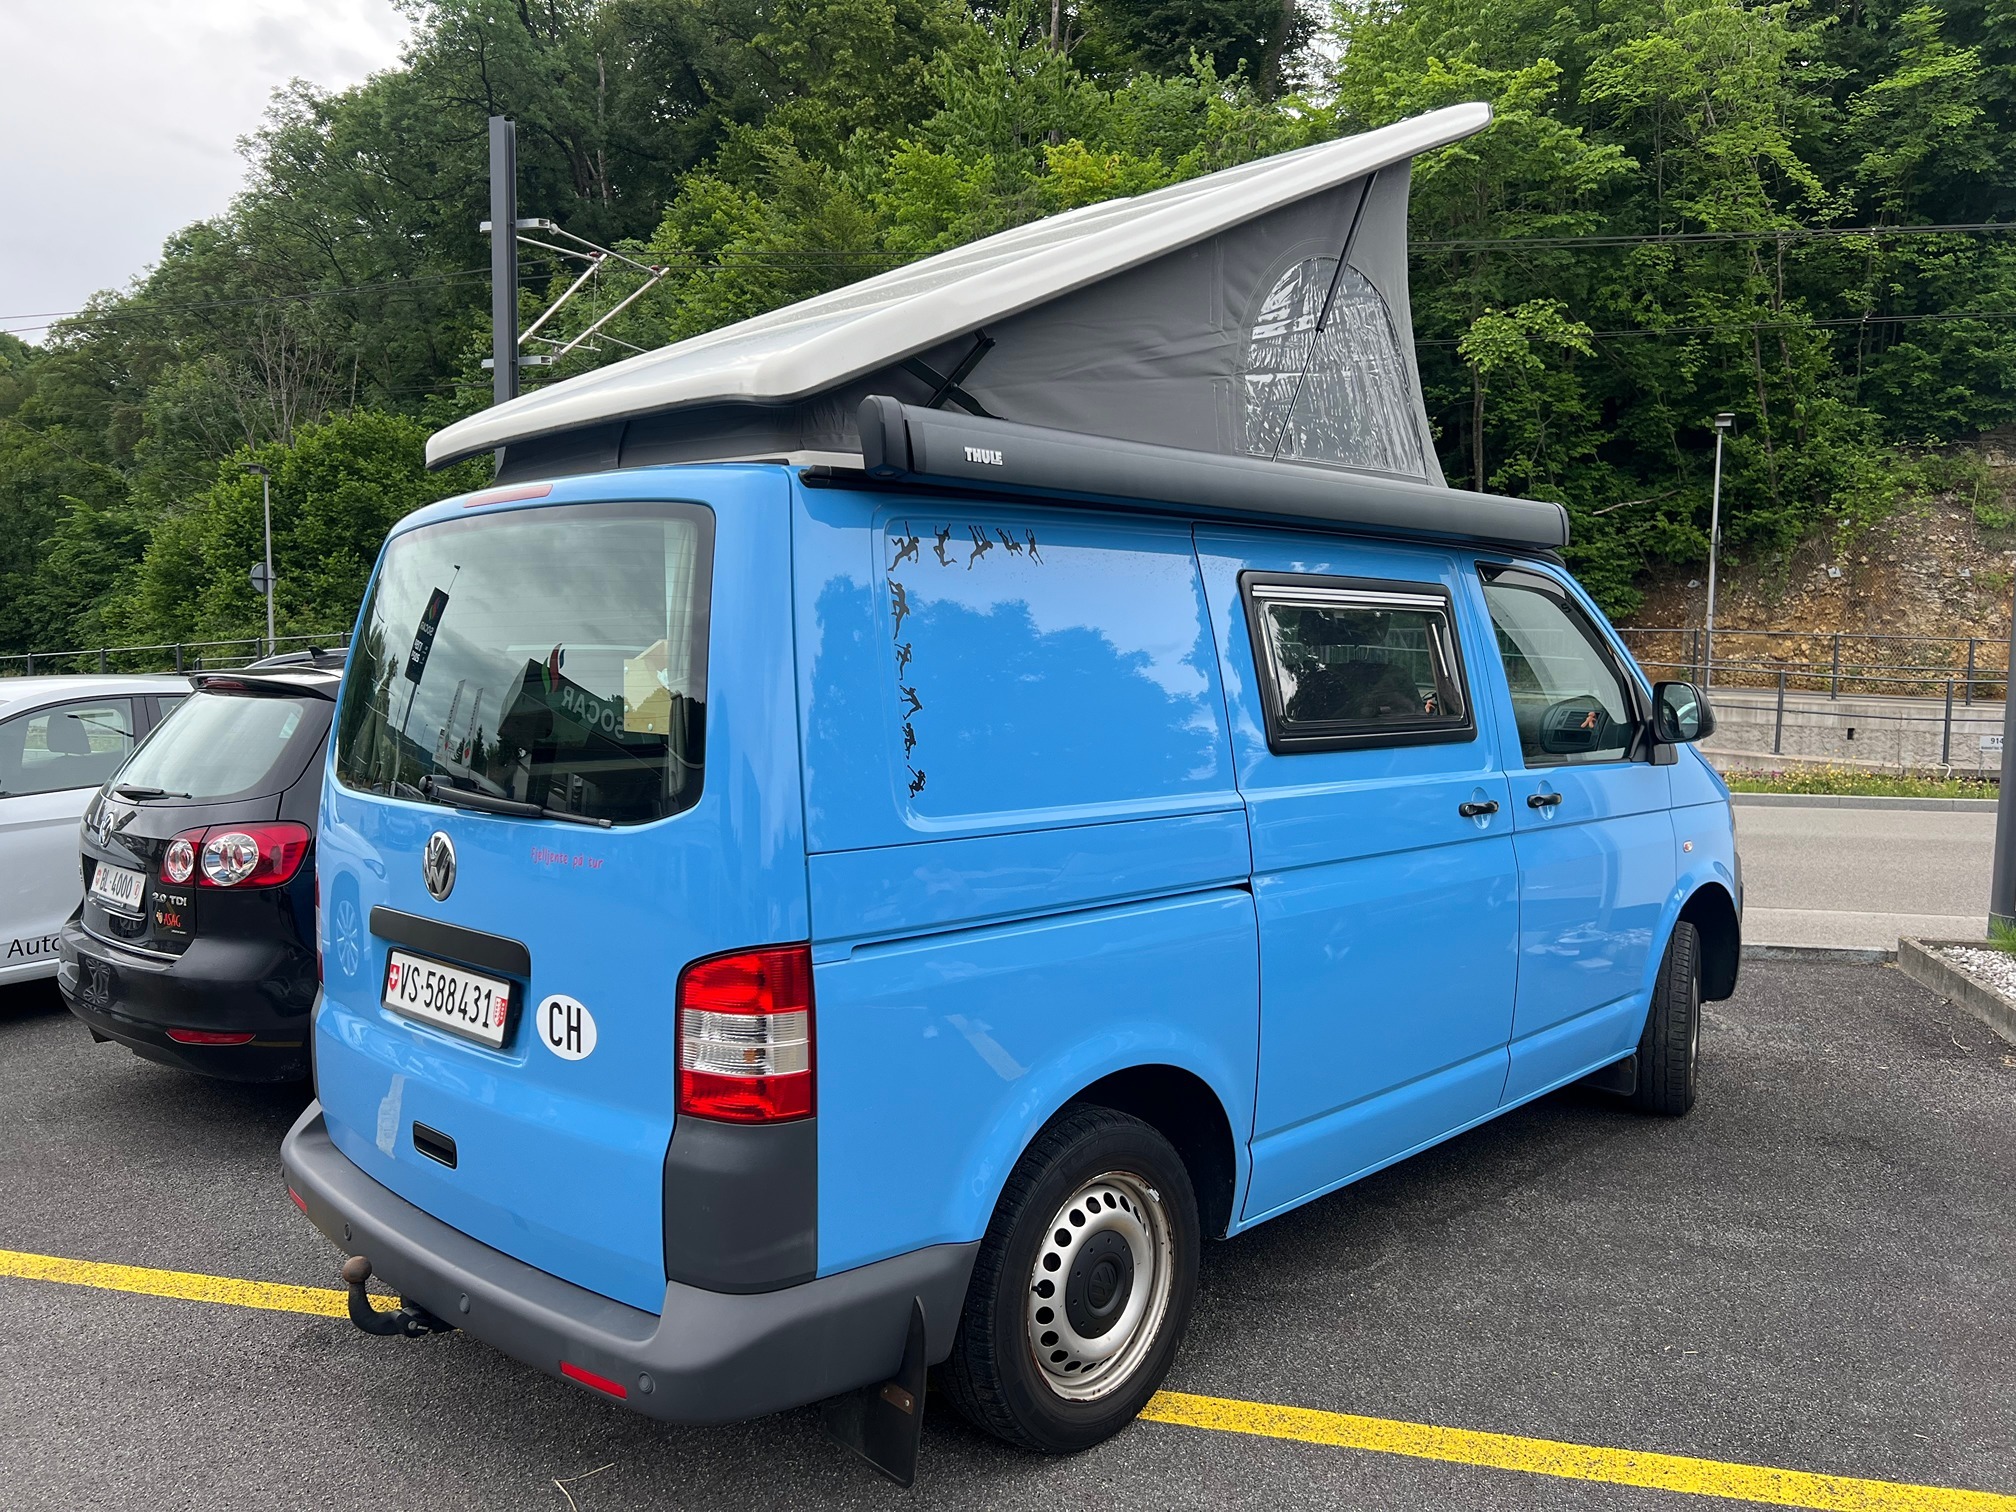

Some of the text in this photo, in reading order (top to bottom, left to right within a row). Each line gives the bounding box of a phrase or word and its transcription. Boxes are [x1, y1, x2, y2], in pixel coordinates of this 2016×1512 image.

[964, 446, 1003, 466] THULE
[588, 857, 604, 868] tur
[169, 895, 188, 907] TDI
[163, 912, 182, 928] ASAG
[7, 936, 60, 959] Auto
[549, 1001, 582, 1053] CH
